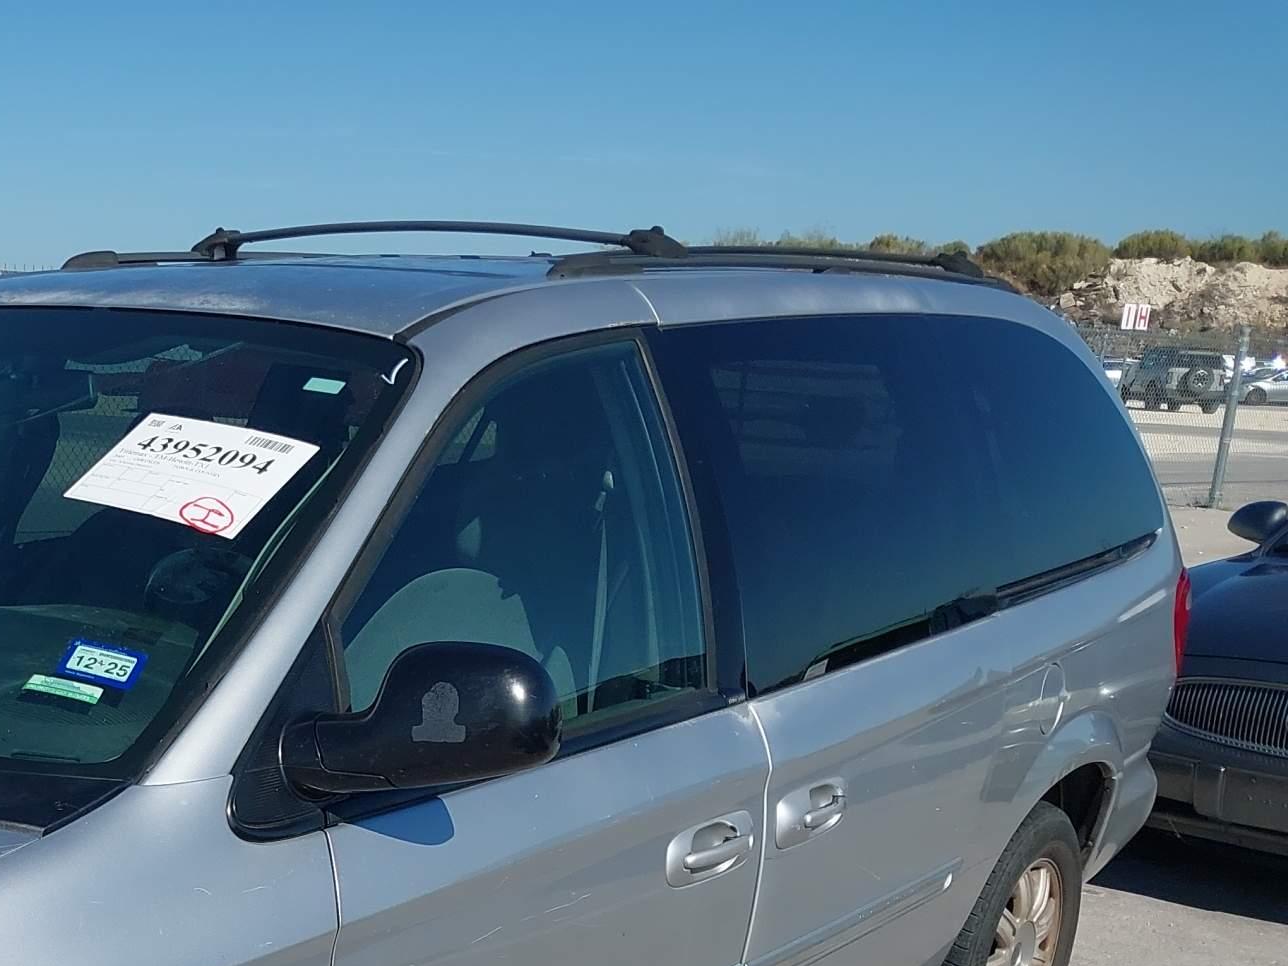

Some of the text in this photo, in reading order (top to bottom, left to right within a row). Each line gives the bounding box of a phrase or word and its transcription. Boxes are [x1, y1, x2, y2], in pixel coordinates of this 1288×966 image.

[136, 434, 276, 475] 43952094
[75, 655, 97, 670] 12
[104, 661, 130, 678] 25
